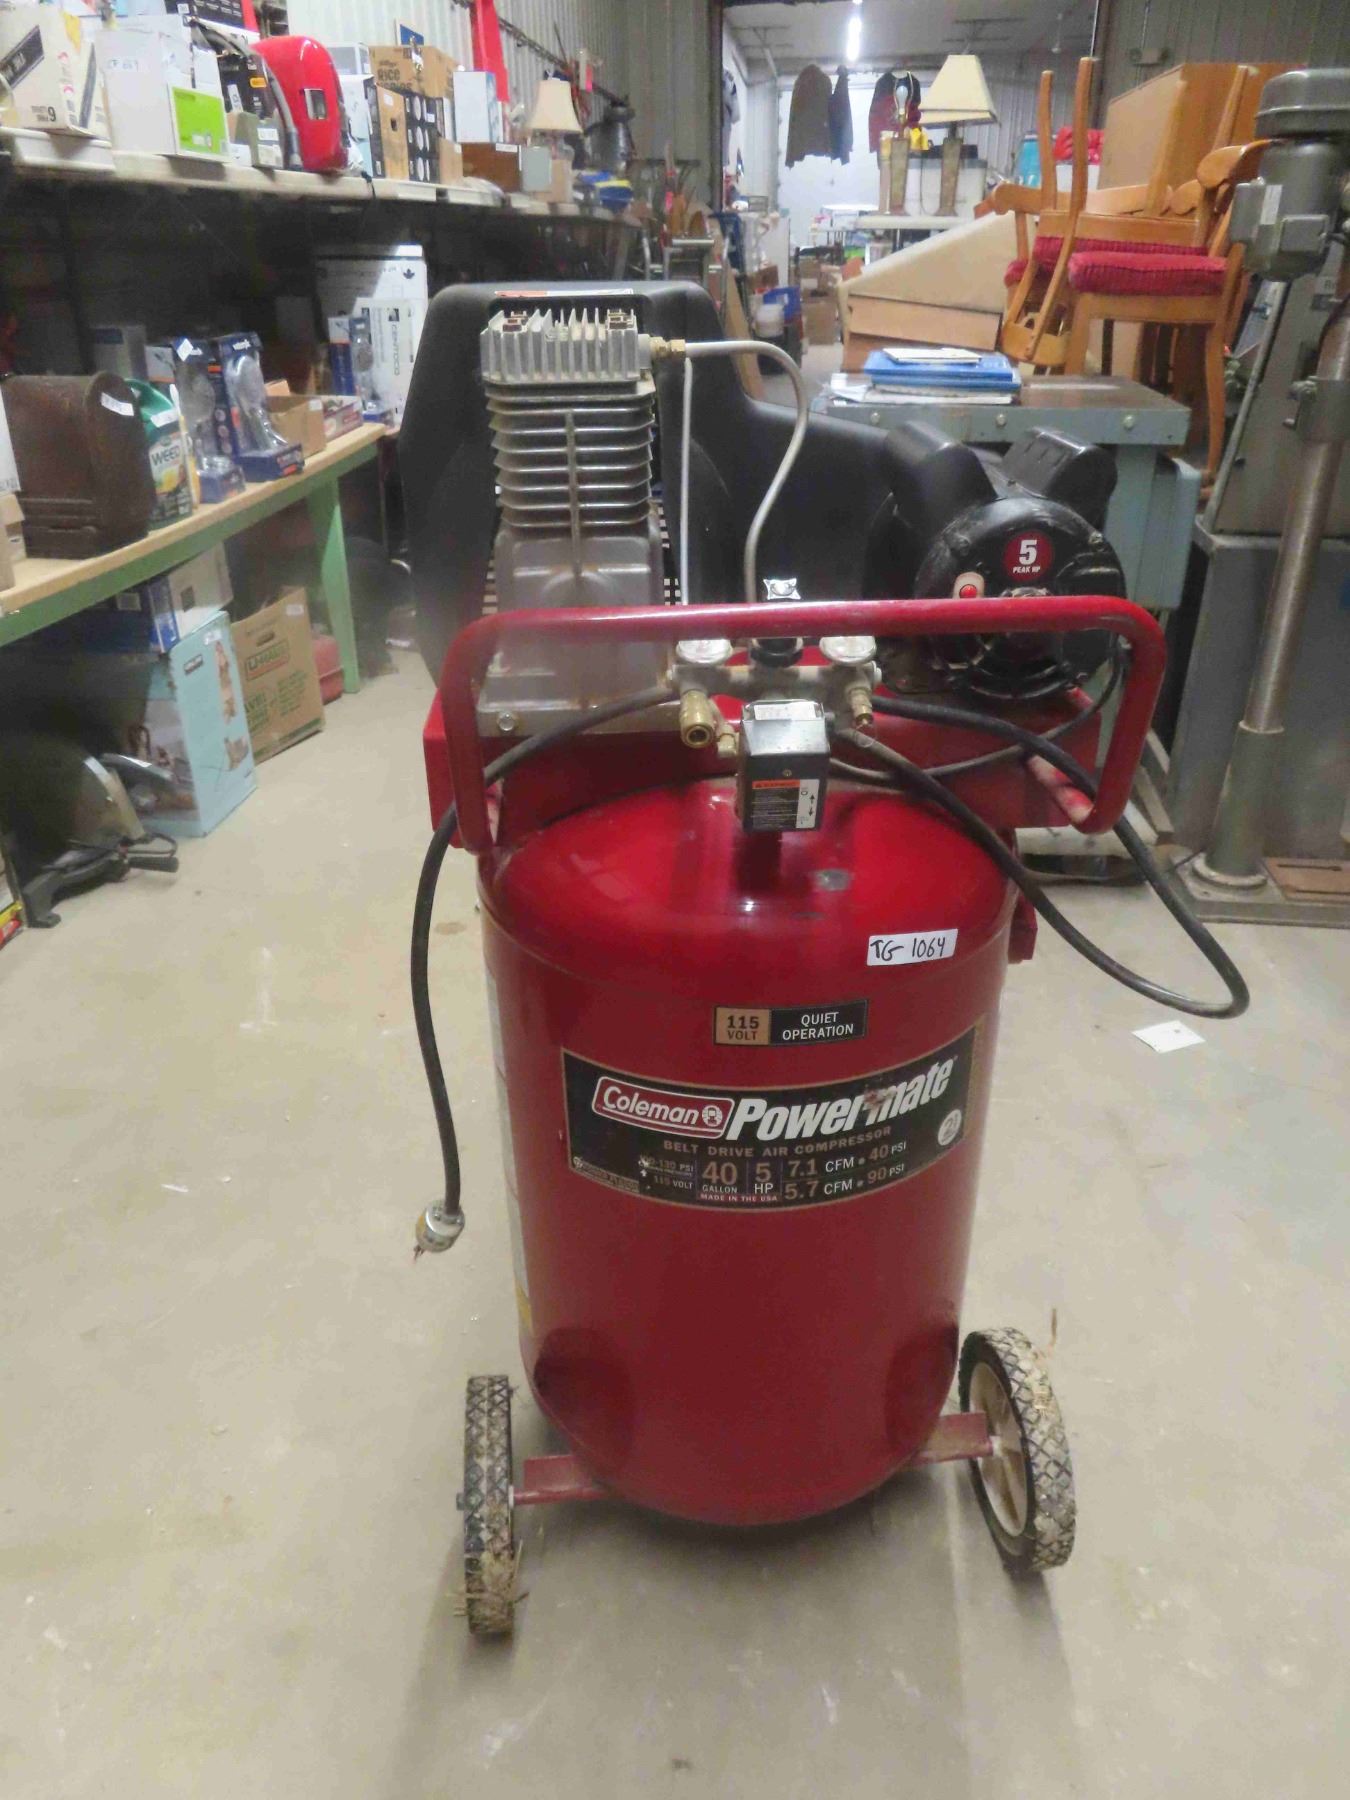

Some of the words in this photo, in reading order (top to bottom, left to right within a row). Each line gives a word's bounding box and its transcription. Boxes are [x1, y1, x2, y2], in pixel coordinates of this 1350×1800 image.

[1019, 539, 1037, 565] 5
[1012, 566, 1031, 574] PEAK
[727, 1015, 760, 1029] 115
[801, 1011, 840, 1027] QUIET
[727, 1031, 759, 1041] VOLT
[782, 1023, 854, 1041] OPERATION
[603, 1086, 700, 1125] Coleman
[725, 1058, 955, 1141] Powermate
[663, 1140, 699, 1154] BELT
[708, 1146, 754, 1158] DRIVE
[762, 1144, 788, 1157] AIR
[794, 1126, 892, 1155] COMPRESSOR
[787, 1158, 818, 1177] 7.1
[825, 1156, 855, 1173] CFM
[868, 1144, 889, 1161] 40
[891, 1141, 907, 1155] PSI
[679, 1163, 694, 1173] PSI
[702, 1161, 738, 1186] 40
[755, 1162, 772, 1183] 5
[672, 1179, 694, 1189] VOLT
[702, 1184, 738, 1194] GALLON
[754, 1183, 774, 1194] HP
[785, 1180, 819, 1200] 5.7
[824, 1178, 853, 1195] CFM
[867, 1166, 888, 1184] 90
[889, 1163, 905, 1177] PSI
[700, 1193, 726, 1201] MADE
